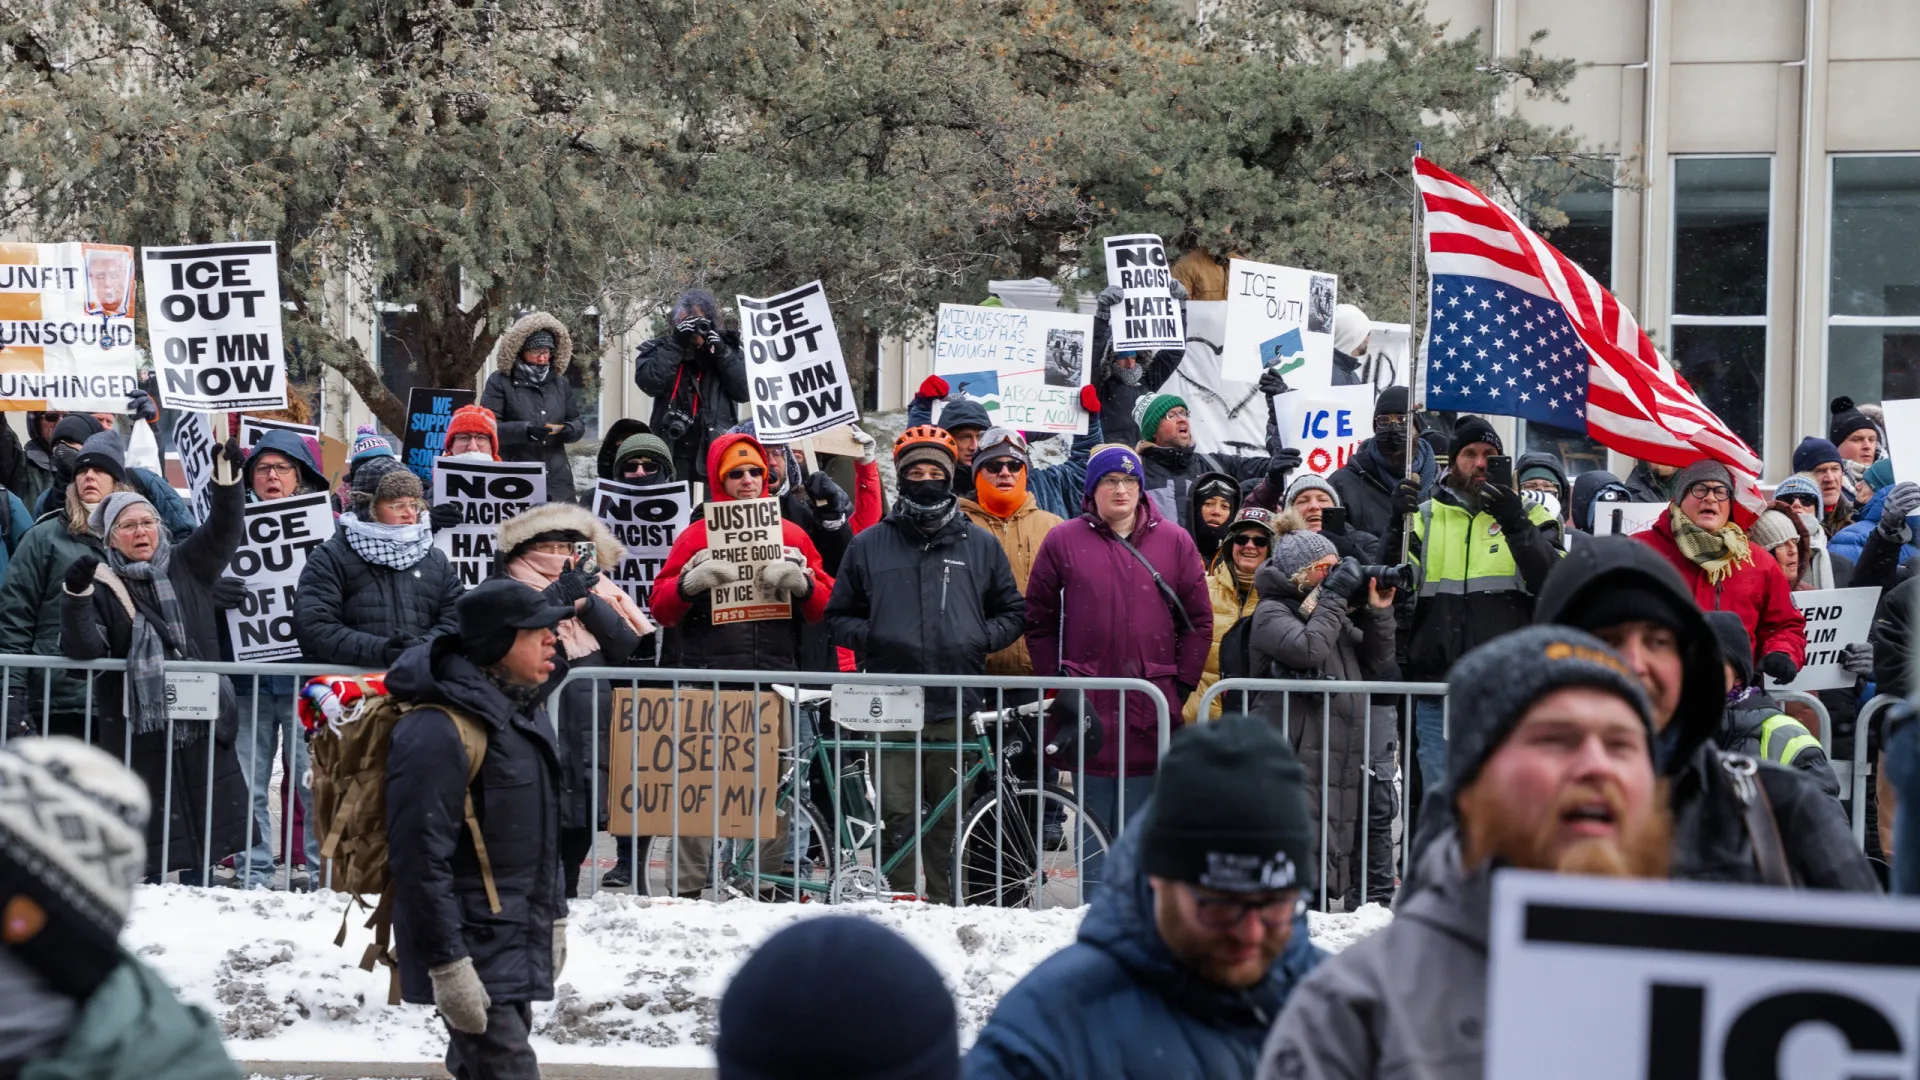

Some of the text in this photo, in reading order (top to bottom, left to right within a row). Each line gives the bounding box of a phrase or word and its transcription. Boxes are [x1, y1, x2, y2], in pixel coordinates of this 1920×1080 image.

[1116, 247, 1167, 268] NO
[0, 266, 78, 289] UNFIT
[170, 259, 252, 291] ICE
[1120, 268, 1170, 289] RACIST
[1239, 271, 1277, 299] ICE
[160, 290, 265, 323] OUT
[939, 308, 1028, 328] MINNESOTA
[1124, 297, 1174, 317] HATE
[1266, 298, 1303, 323] OUT!
[749, 302, 810, 337] ICE
[1125, 319, 1177, 339] IN MN
[0, 322, 133, 347] UNSOUND
[749, 325, 823, 365] OUT
[938, 324, 1026, 344] ALREADY HAS
[164, 333, 270, 365] OF MN
[937, 342, 1038, 364] ENOUGH ICE
[0, 374, 137, 398] UNHINGED
[164, 365, 275, 397] NOW
[754, 360, 837, 402] OF MN
[432, 396, 454, 415] WE
[756, 386, 843, 429] NOW
[1003, 385, 1081, 406] ABOLISH
[410, 413, 453, 432] SUPPO
[1004, 405, 1036, 424] ICE
[1302, 410, 1353, 439] ICE
[179, 418, 203, 460] CE
[424, 432, 447, 450] OU
[409, 448, 440, 467] SOM
[1307, 440, 1365, 474] OU
[446, 473, 534, 500] NO
[598, 495, 679, 522] NO
[707, 501, 780, 532] JUSTICE
[452, 533, 498, 557] HA
[606, 524, 676, 547] ACIST
[724, 530, 769, 544] FOR
[230, 538, 325, 577] OUT
[711, 544, 783, 563] RENEE GOOD
[604, 558, 668, 582] AT
[738, 565, 754, 581] ED
[239, 588, 276, 618] OF
[715, 585, 754, 605] BY ICE
[1800, 606, 1843, 621] END
[238, 615, 296, 648] NO
[1804, 628, 1837, 644] LIM
[620, 697, 773, 735] BOOTLICKING
[630, 734, 757, 774] LOSERS
[621, 783, 767, 816] OUT OF MN
[1648, 980, 1907, 1080] IC
